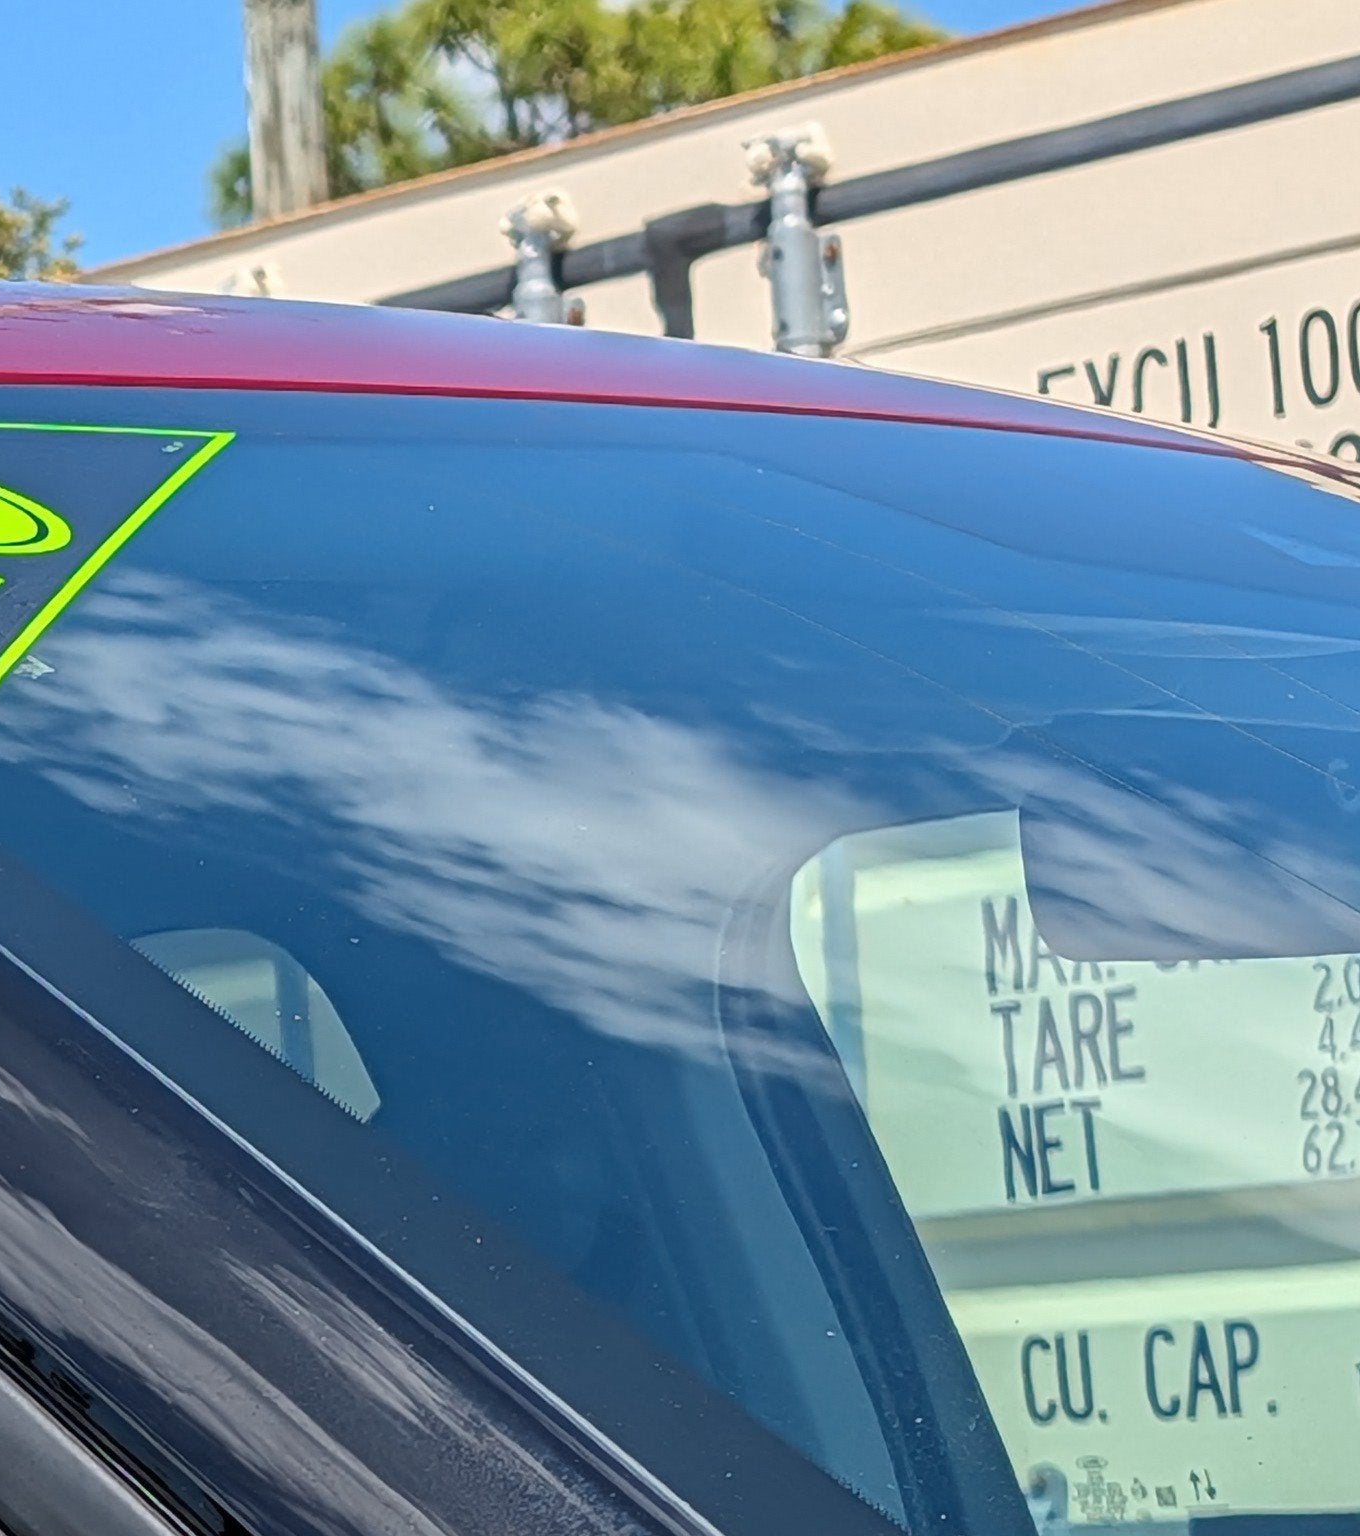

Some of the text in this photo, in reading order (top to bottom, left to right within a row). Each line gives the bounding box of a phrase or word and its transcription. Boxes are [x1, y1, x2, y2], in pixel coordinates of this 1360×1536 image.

[990, 984, 1146, 1098] TARE
[997, 1097, 1102, 1202] NET
[1021, 1319, 1279, 1424] CU. CAP.
